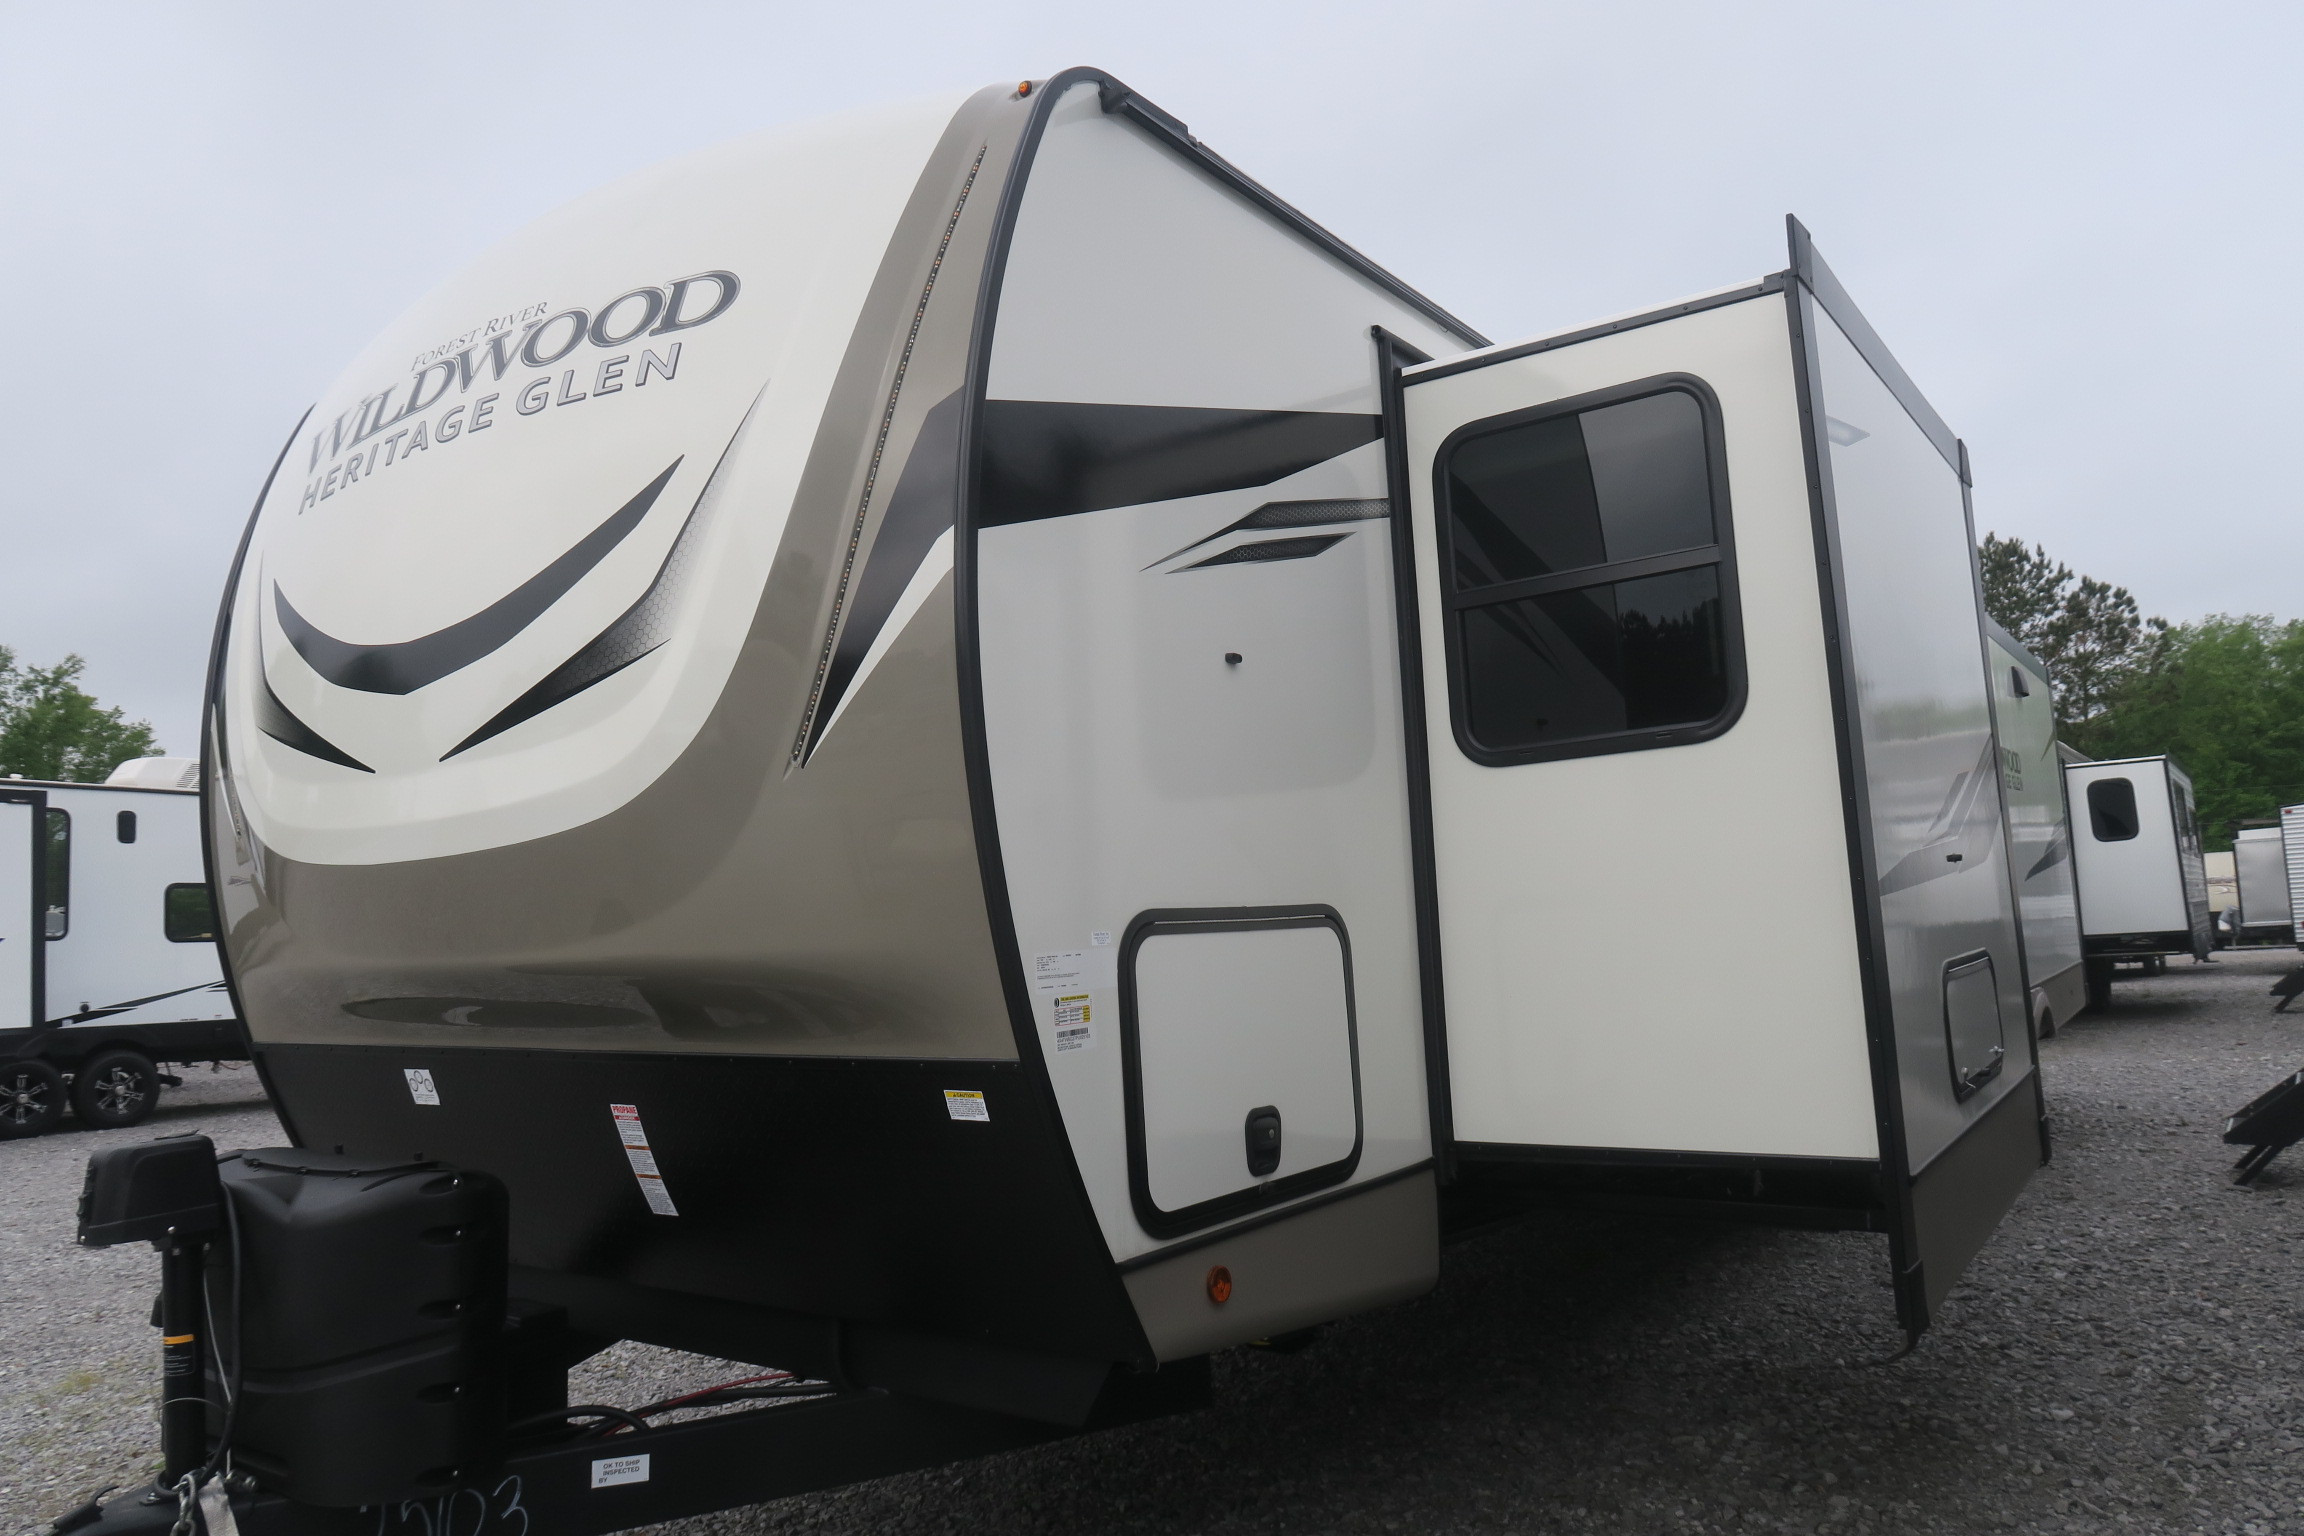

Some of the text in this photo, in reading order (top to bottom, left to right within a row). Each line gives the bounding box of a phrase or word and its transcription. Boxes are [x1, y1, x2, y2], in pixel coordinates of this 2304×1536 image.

[410, 301, 549, 373] FOREST RIVER
[305, 269, 742, 475] WILDWOOD
[297, 341, 683, 516] HERITAGE GLEN
[611, 1105, 638, 1115] PROPANE
[602, 1466, 640, 1476] INSPECTED
[625, 1459, 641, 1467] SHIP
